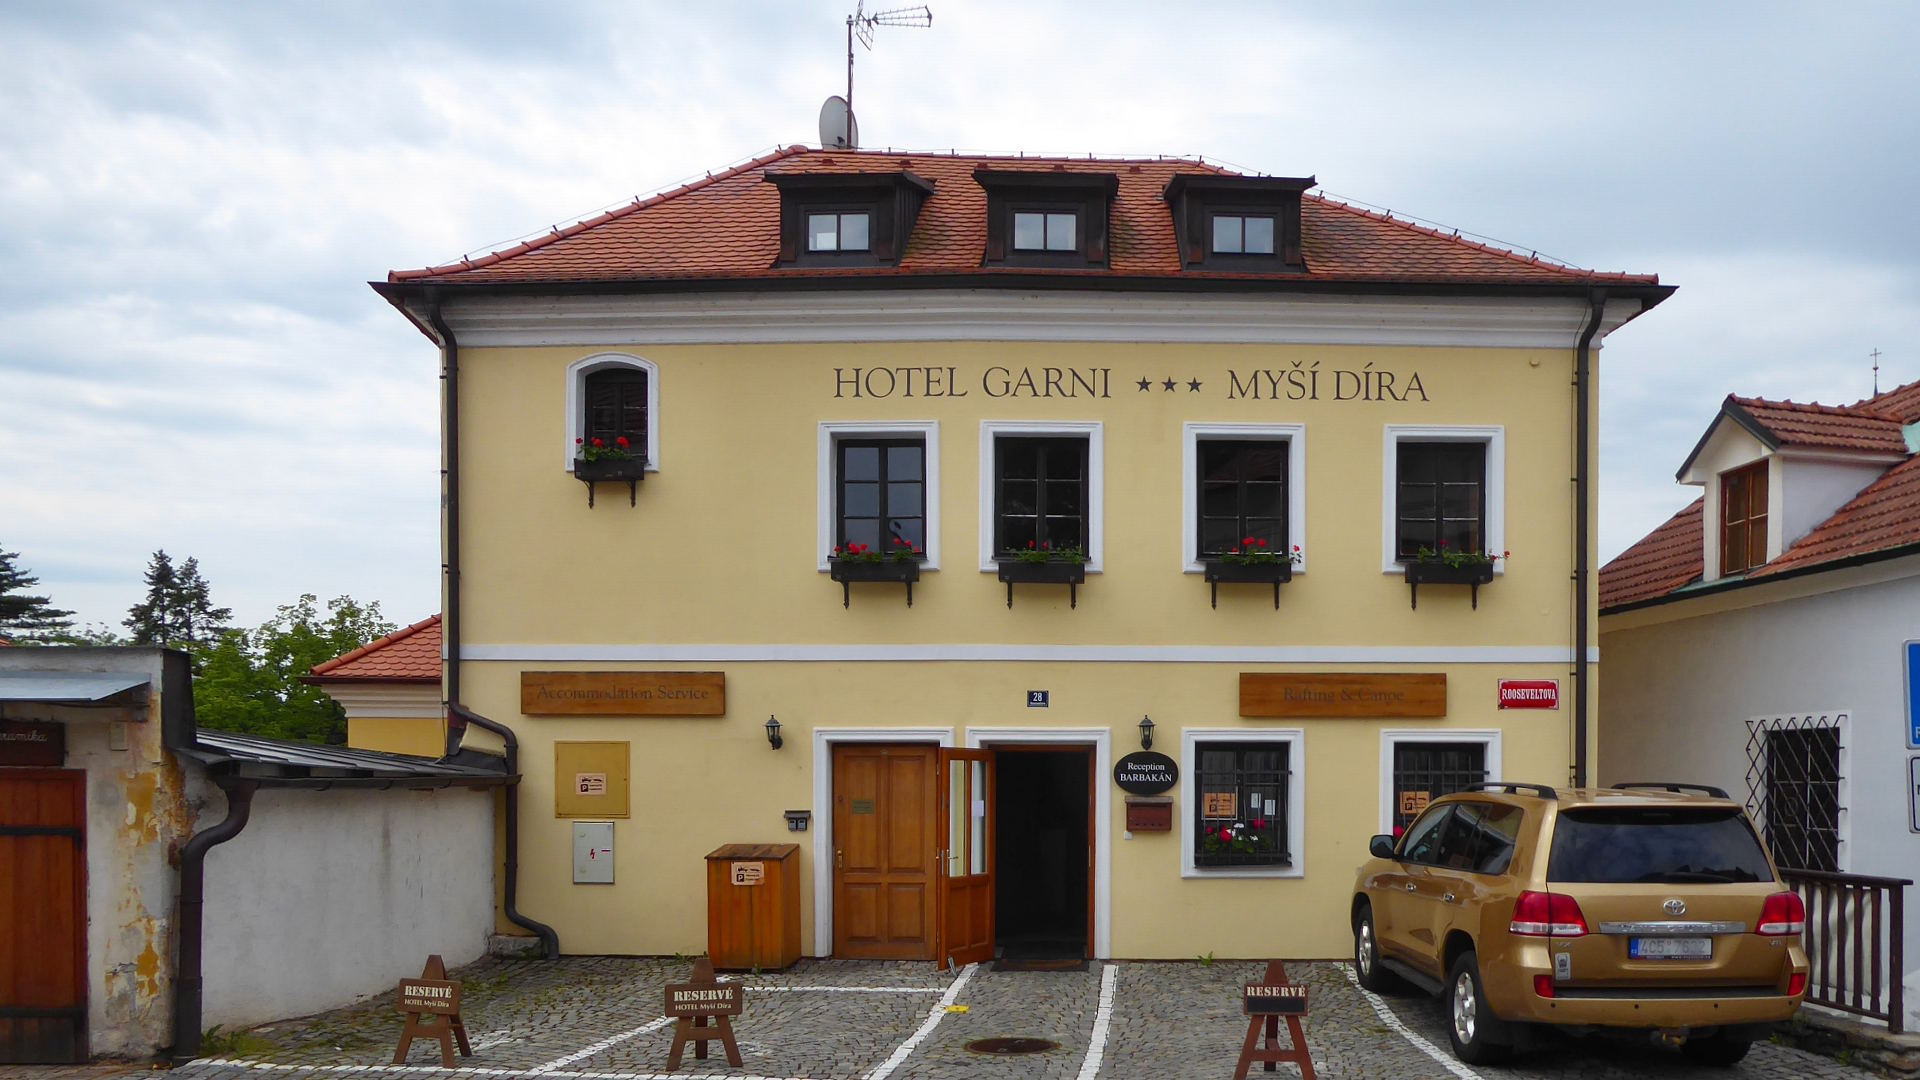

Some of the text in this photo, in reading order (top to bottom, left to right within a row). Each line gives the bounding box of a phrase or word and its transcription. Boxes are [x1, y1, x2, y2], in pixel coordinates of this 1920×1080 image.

[833, 360, 1430, 401] HOTEL GARNI MYŠÍ DÍRA
[537, 684, 709, 700] Accommodation Service
[1032, 692, 1043, 702] 28
[1501, 688, 1556, 700] ROOSEVELTOVA
[0, 729, 49, 742] ramika
[1127, 762, 1165, 772] Reception
[1120, 772, 1172, 782] BARBAKÁN
[404, 985, 452, 999] RESERVÉ
[673, 987, 733, 1002] RESERVÉ
[1246, 985, 1306, 997] RESERVÉ
[675, 1003, 698, 1011] HOTEL
